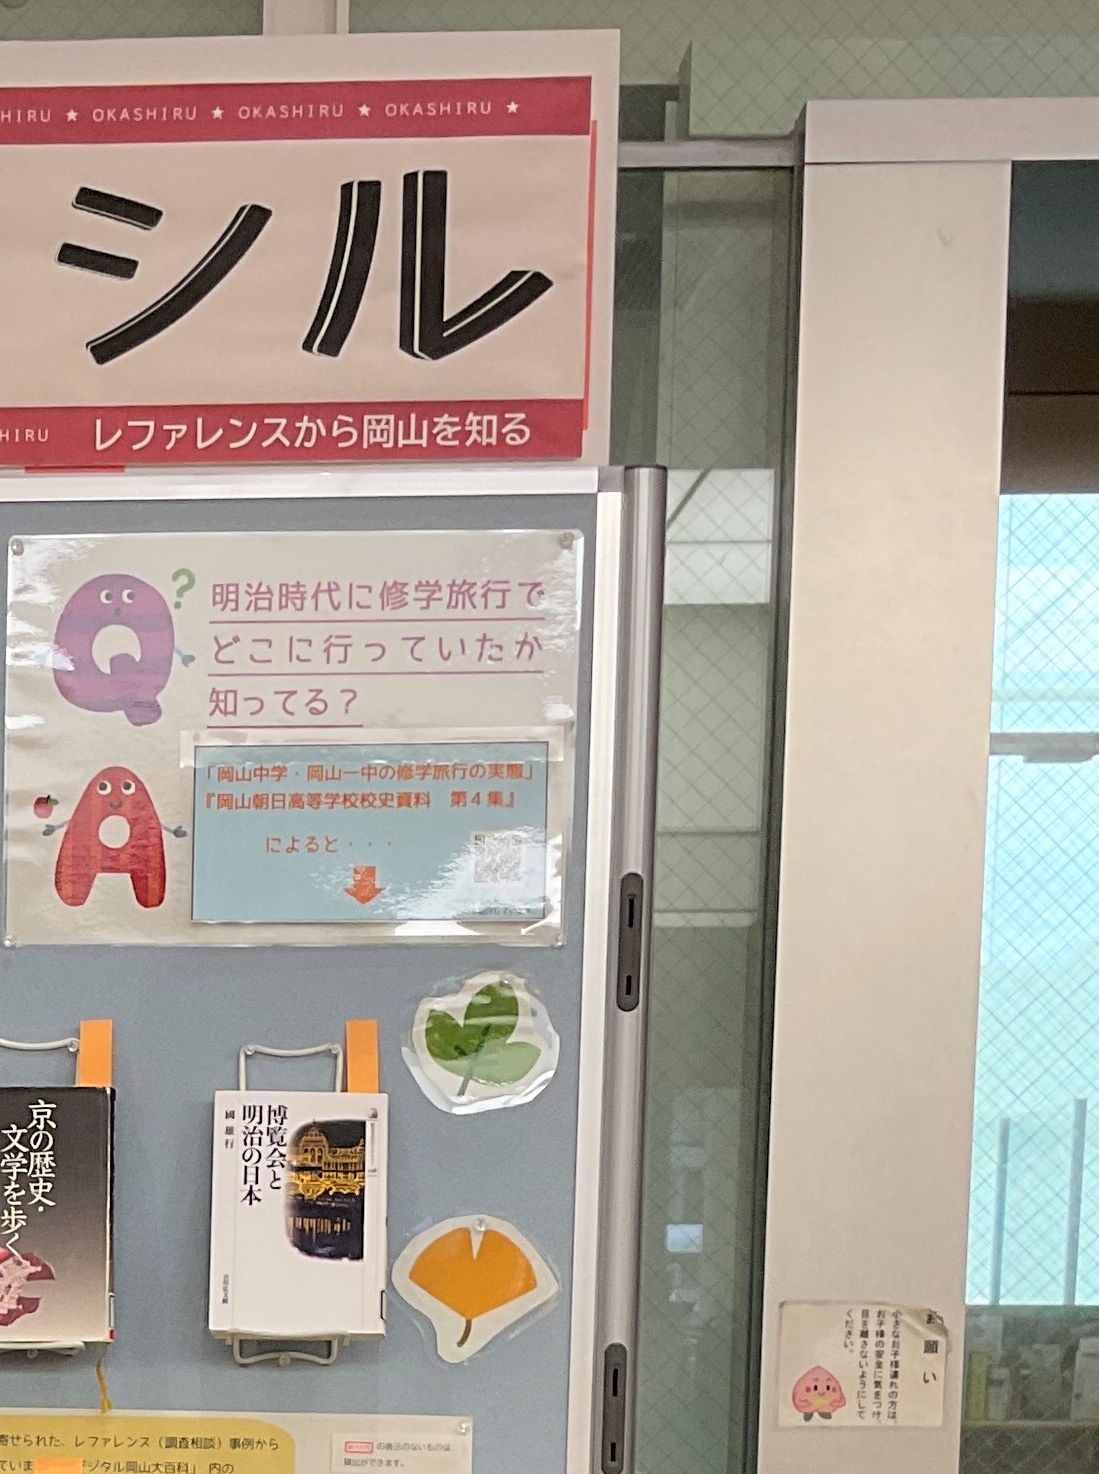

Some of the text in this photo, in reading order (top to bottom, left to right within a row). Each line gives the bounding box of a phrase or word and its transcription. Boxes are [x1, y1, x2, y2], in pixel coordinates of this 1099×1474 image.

[92, 106, 197, 122] OKASHIRU
[238, 103, 343, 119] OKASHIRU
[385, 101, 492, 117] OKASHIRU
[94, 411, 532, 452] レファレンスから岡山を知る
[211, 579, 546, 613] 明治時代に修学旅行で
[212, 633, 545, 665] どこに行っていたか
[208, 687, 360, 719] 知ってる？
[240, 1104, 263, 1206] 明治の日本
[266, 1104, 288, 1190] 博覧会と
[0, 1123, 30, 1260] 文学を歩く
